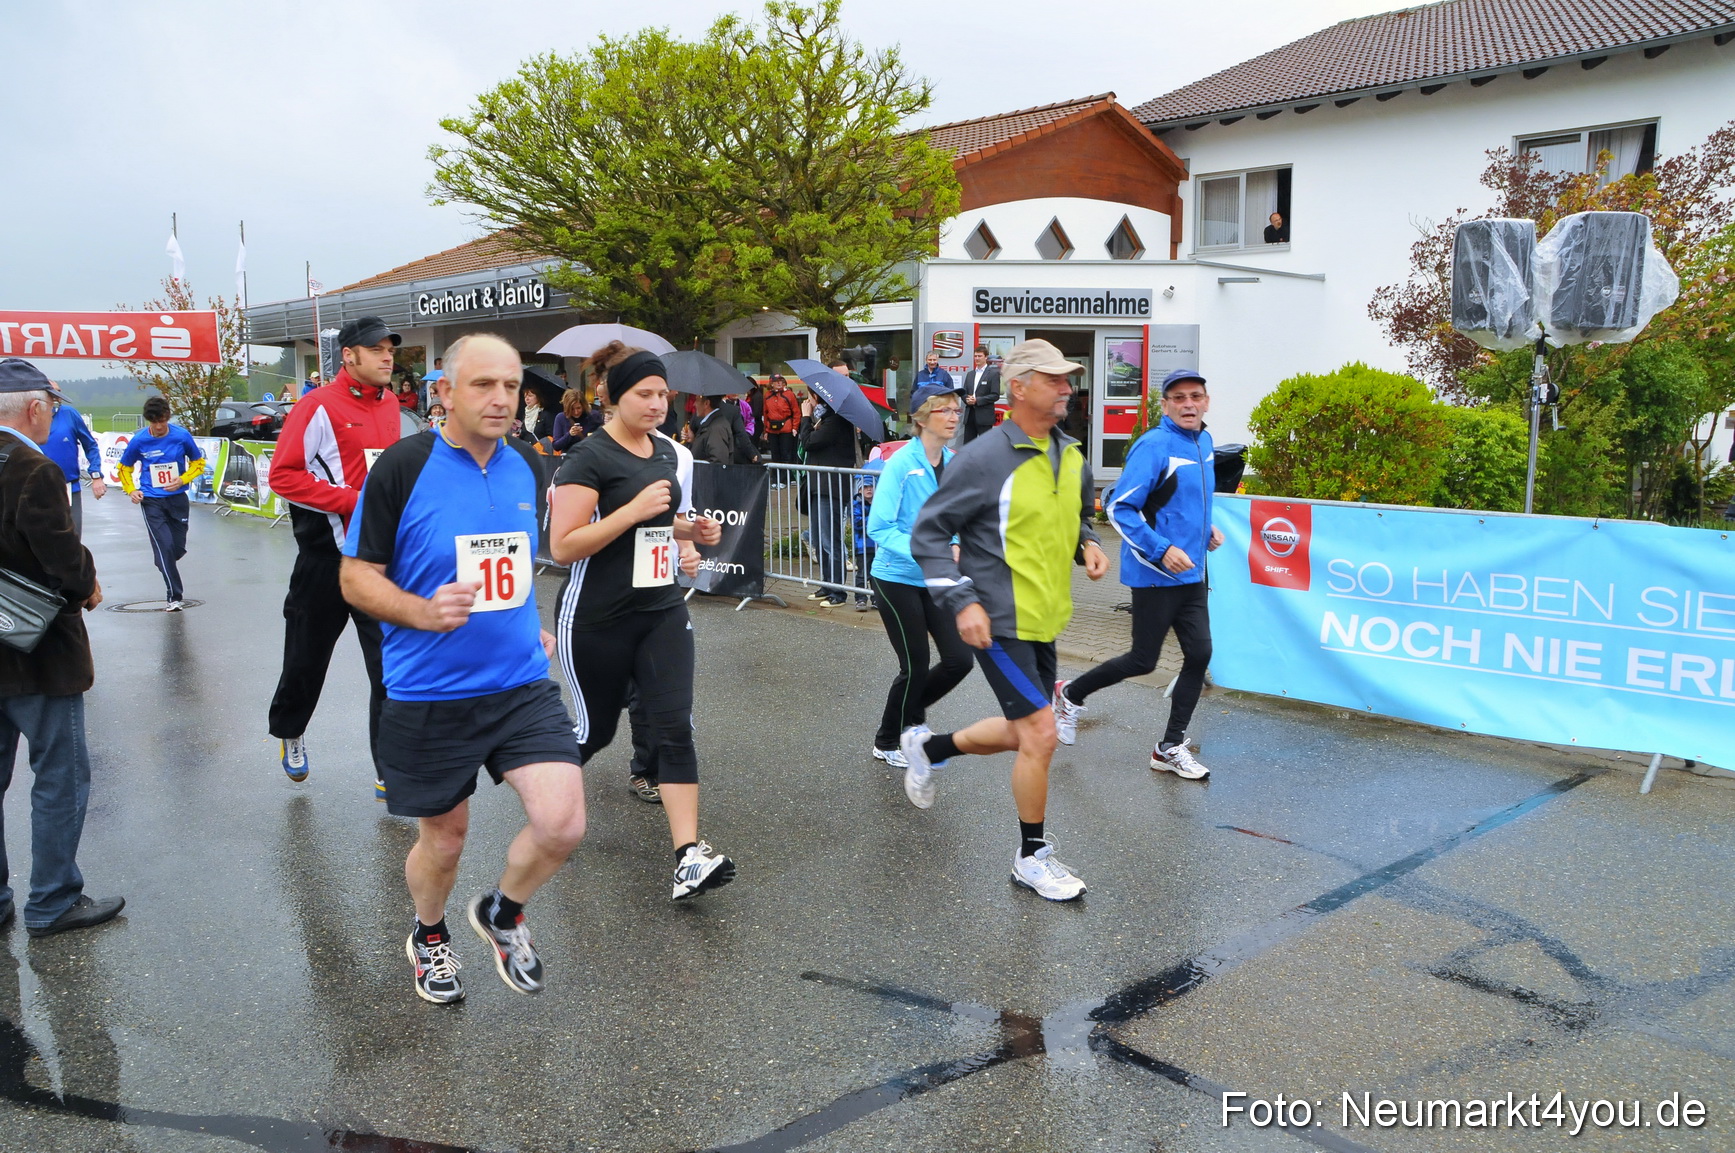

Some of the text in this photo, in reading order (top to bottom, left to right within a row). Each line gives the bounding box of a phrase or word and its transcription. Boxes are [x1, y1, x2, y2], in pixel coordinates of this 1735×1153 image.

[418, 278, 545, 316] Gerhart & Jänig
[975, 289, 1149, 315] Serviceannahme
[157, 470, 172, 484] 81
[703, 508, 748, 526] SOON
[470, 538, 505, 549] MEYER
[644, 529, 666, 538] MEYER
[1262, 532, 1297, 543] NISSAN
[471, 547, 506, 556] WERBUNG
[651, 546, 669, 579] 15
[479, 556, 515, 602] 16
[1326, 558, 1735, 634] SO HABEN SIE
[1319, 611, 1481, 665] NOCH
[1502, 632, 1603, 681] NIE
